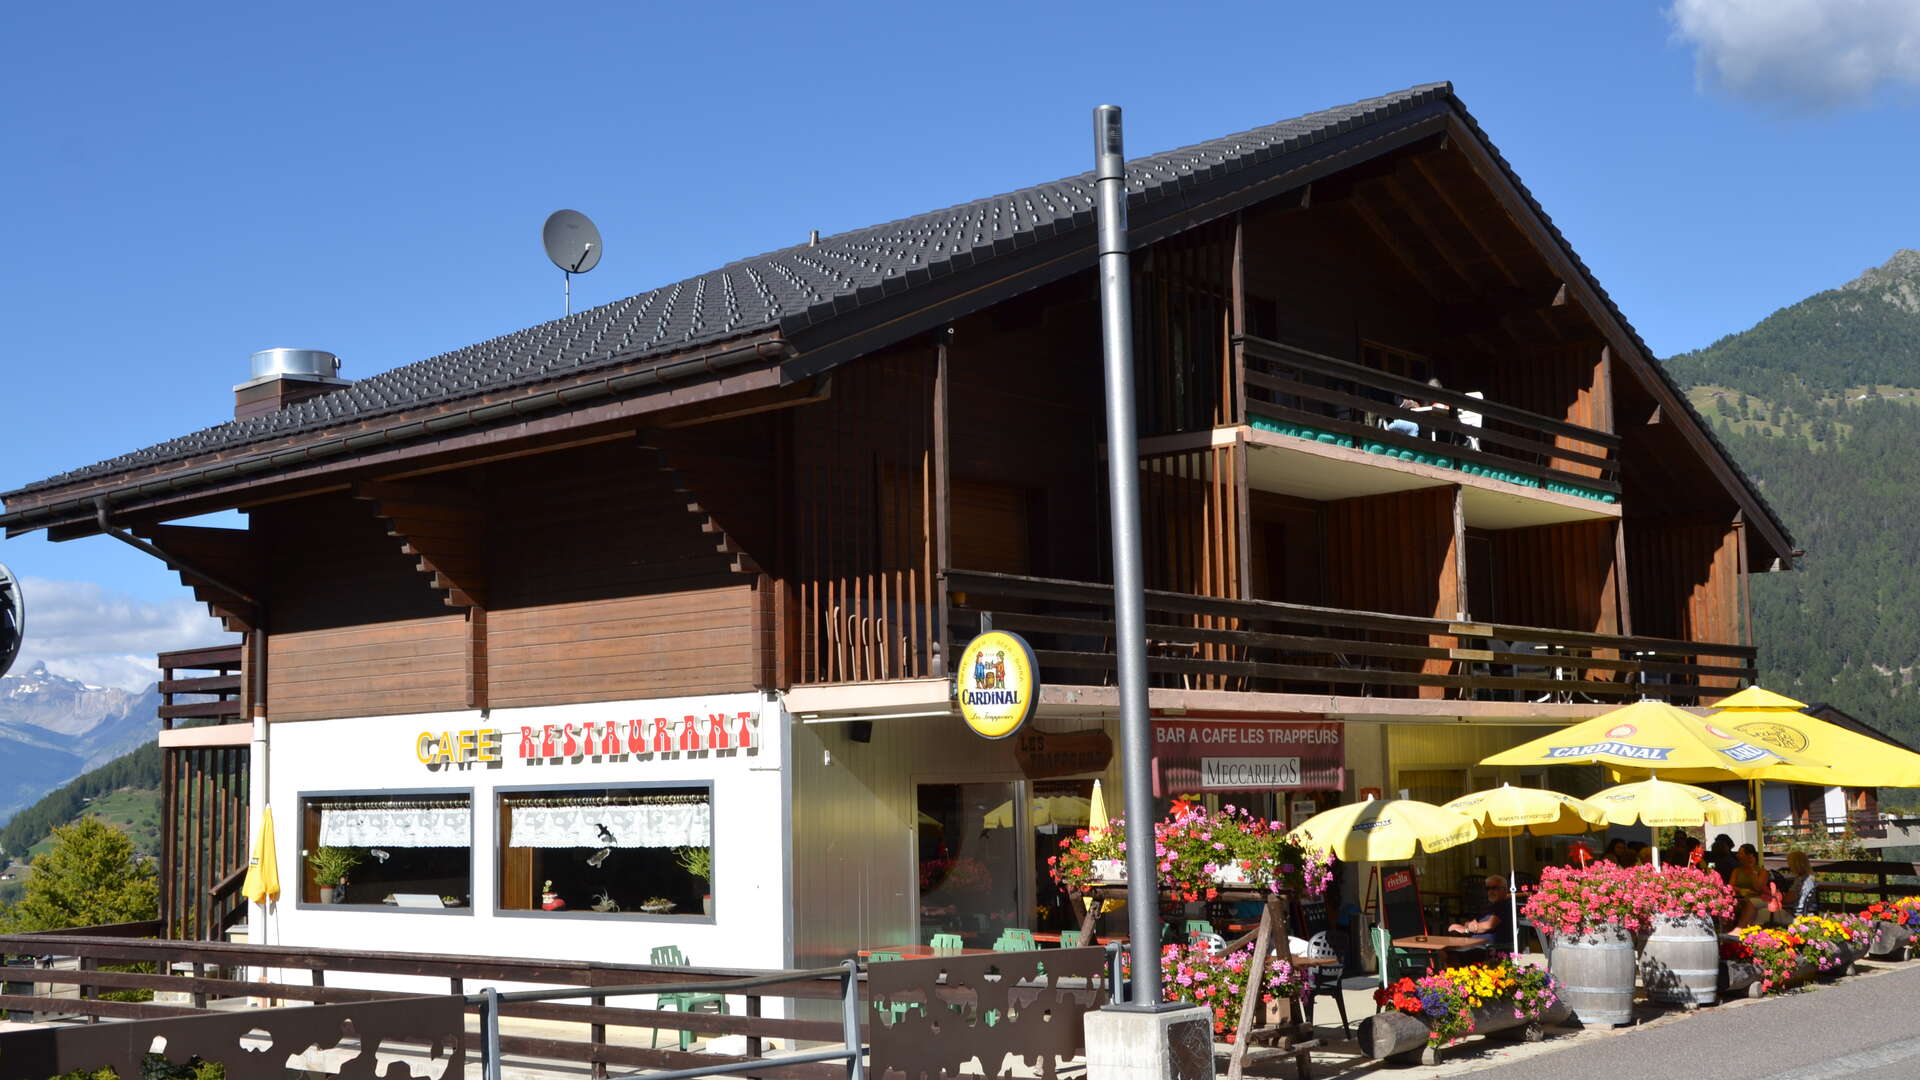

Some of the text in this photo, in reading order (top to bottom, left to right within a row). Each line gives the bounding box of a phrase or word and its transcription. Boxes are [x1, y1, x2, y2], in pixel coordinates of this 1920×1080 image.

[415, 712, 751, 764] CAFE RESTAURANT
[1157, 727, 1339, 745] BAR A CAFE LES TRAPPEURS
[1553, 743, 1662, 759] CARDINAL
[1725, 743, 1762, 761] CARD
[1207, 759, 1297, 785] MECCARILLOS
